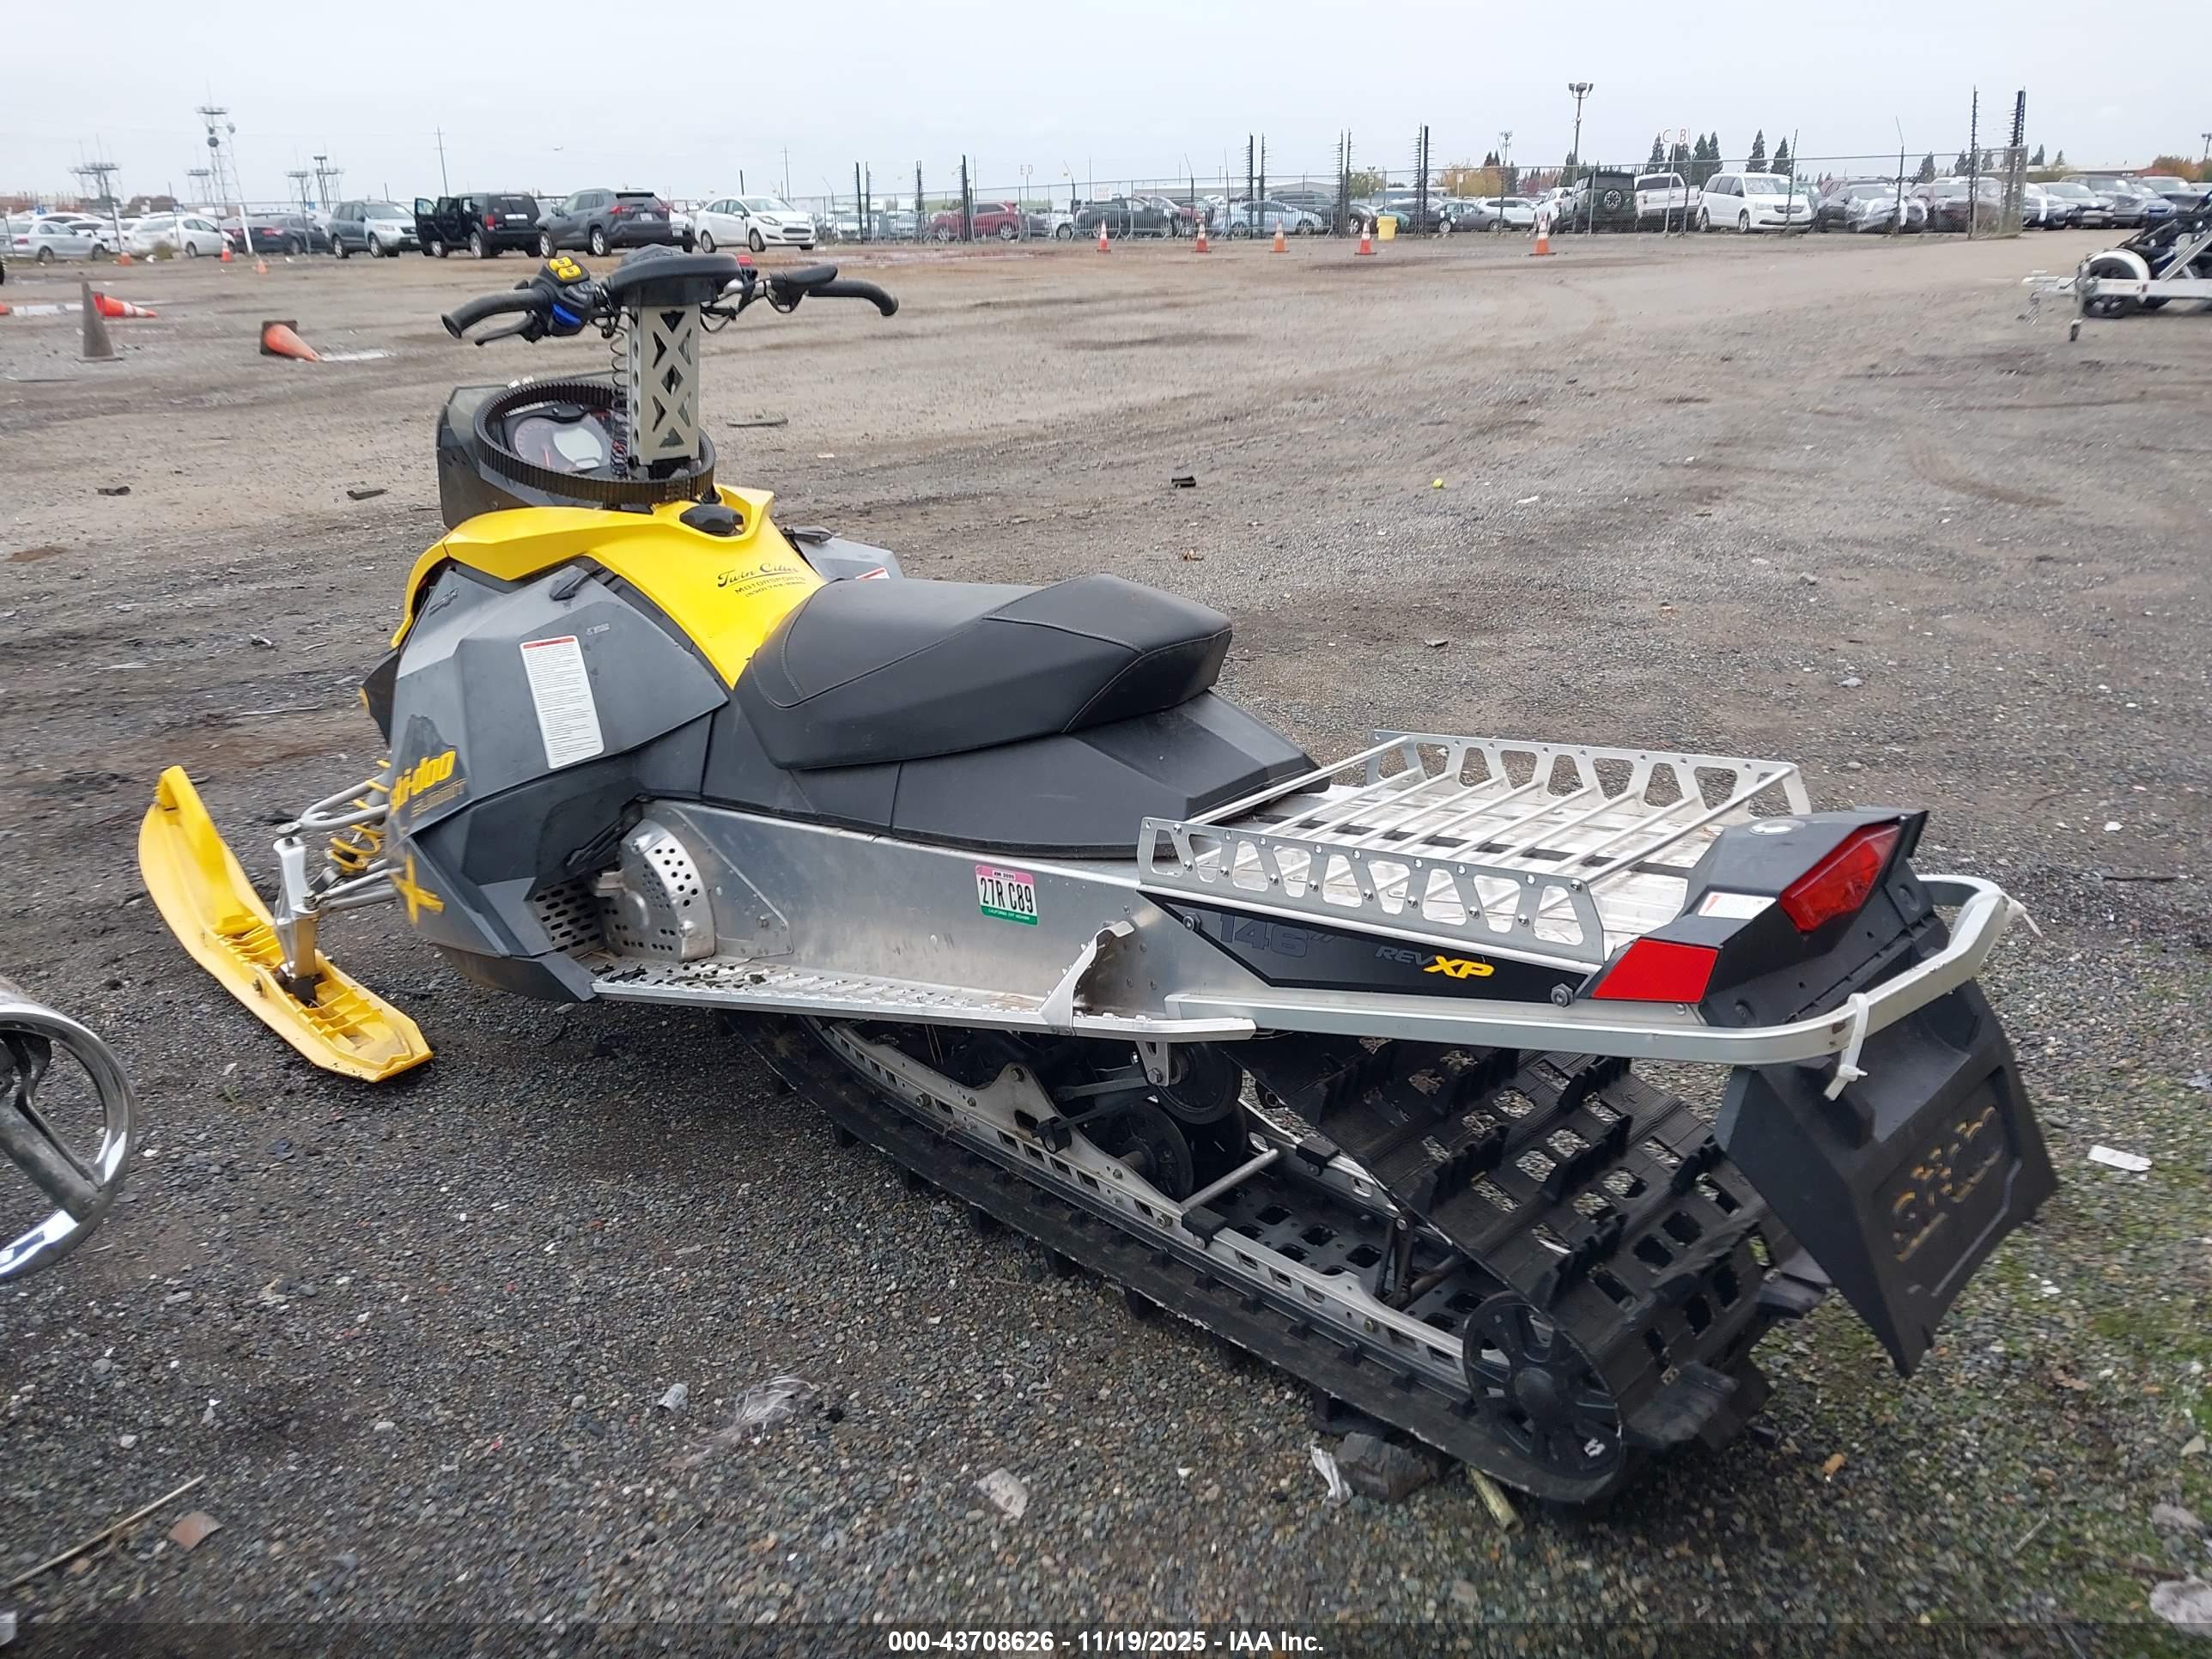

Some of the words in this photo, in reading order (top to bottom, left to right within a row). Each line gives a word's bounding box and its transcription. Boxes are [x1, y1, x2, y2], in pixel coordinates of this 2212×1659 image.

[1680, 128, 1686, 143] B
[717, 568, 757, 588] Twin
[981, 878, 1006, 908] 27R
[1008, 882, 1034, 914] C89
